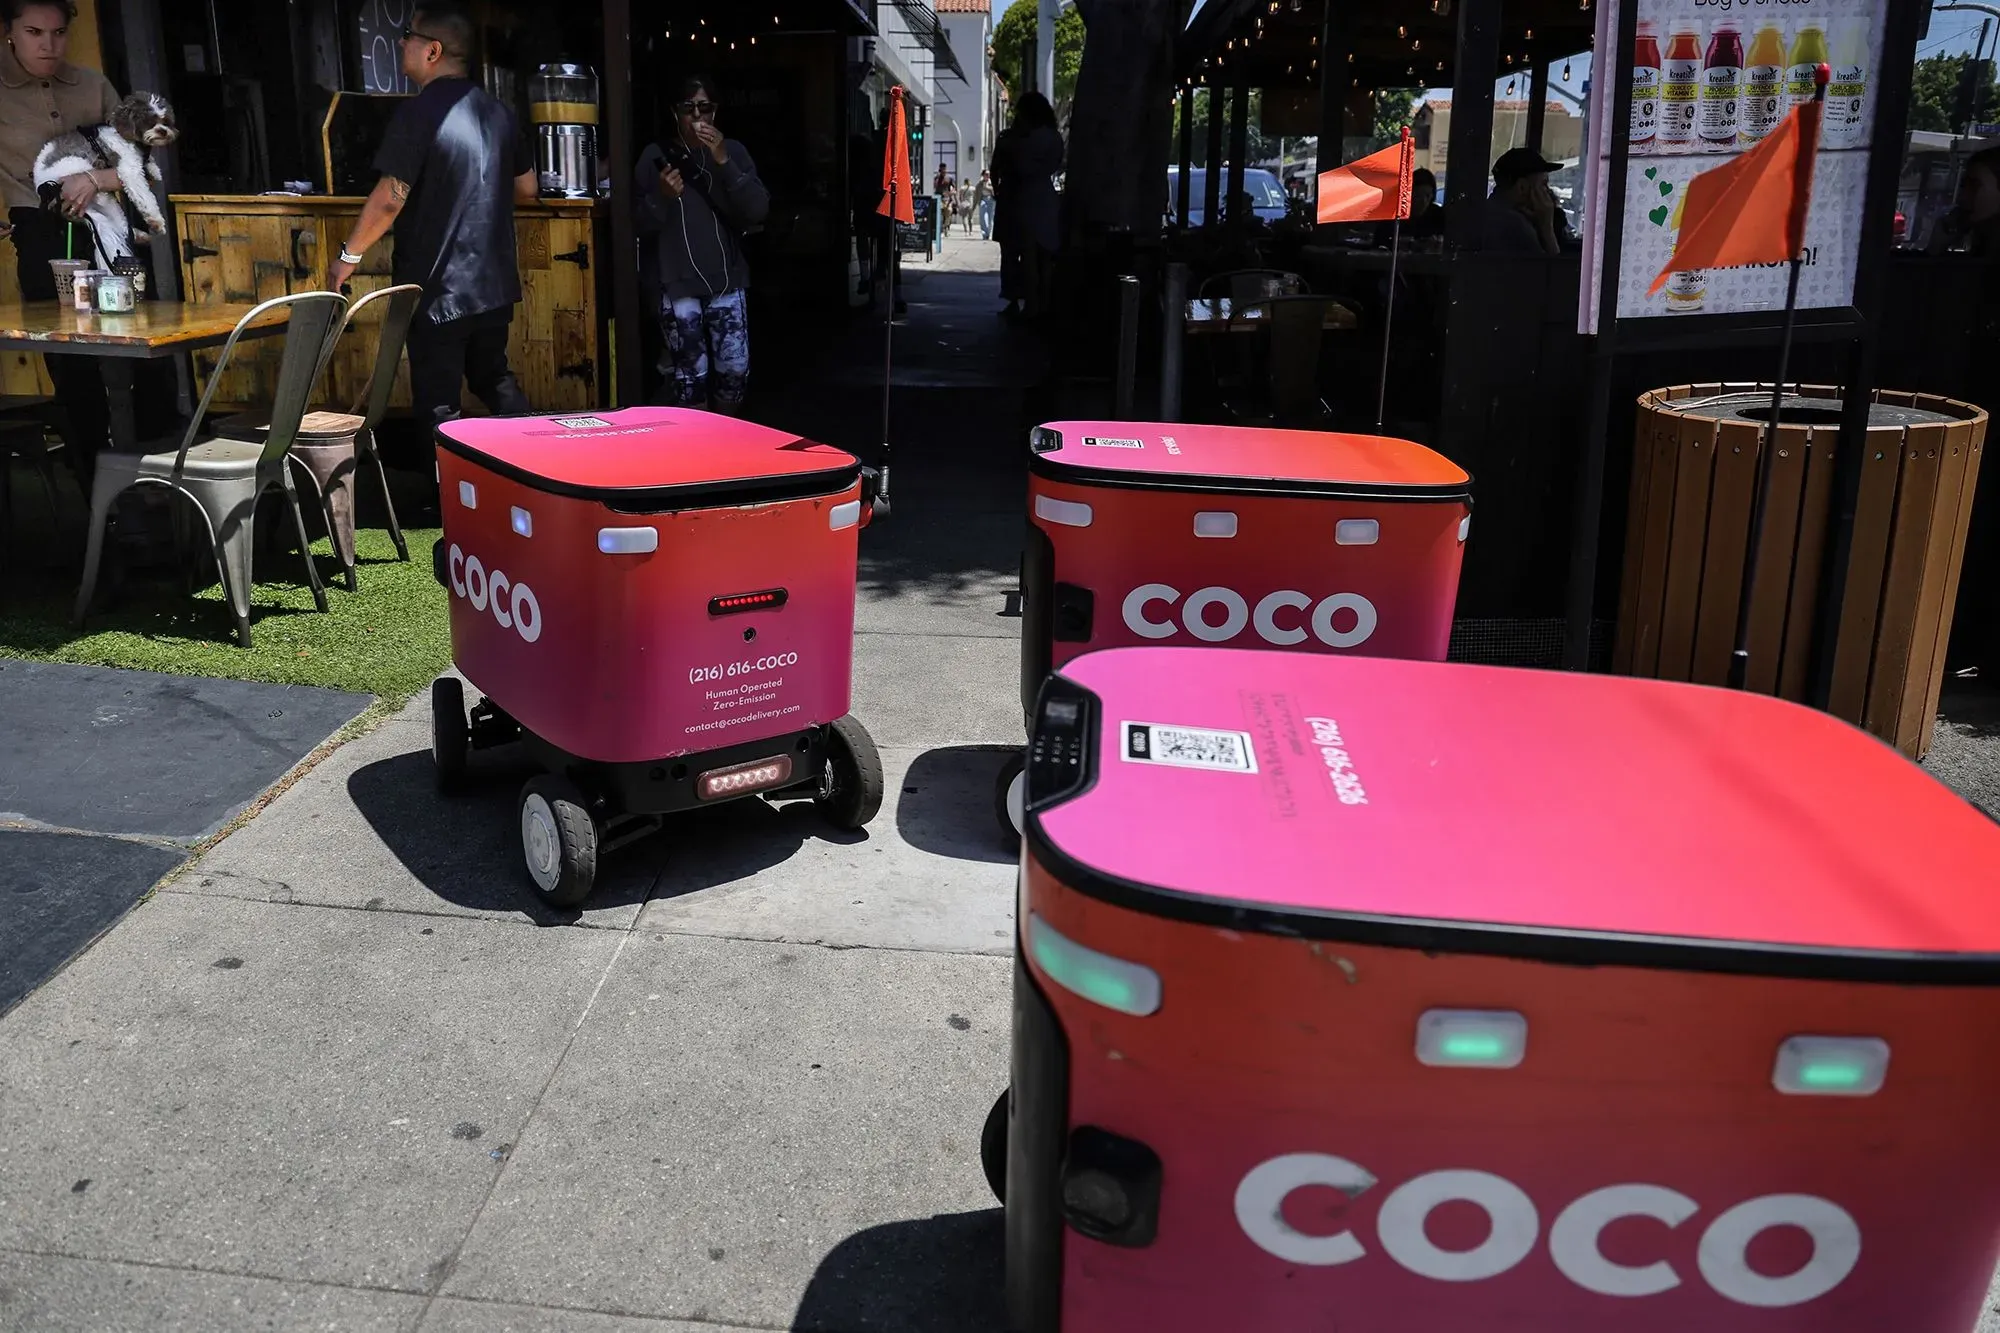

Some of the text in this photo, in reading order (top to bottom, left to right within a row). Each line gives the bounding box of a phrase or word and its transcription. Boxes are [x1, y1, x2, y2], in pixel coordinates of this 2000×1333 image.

[449, 543, 542, 643] COCO
[1122, 583, 1378, 648] COCO
[689, 651, 798, 684] (216) 616-COCO
[705, 677, 783, 700] Human Operated
[713, 692, 776, 711] Zero-Emission
[684, 704, 801, 734] contact@cocodelivery.com
[1234, 1152, 1862, 1308] COCO
